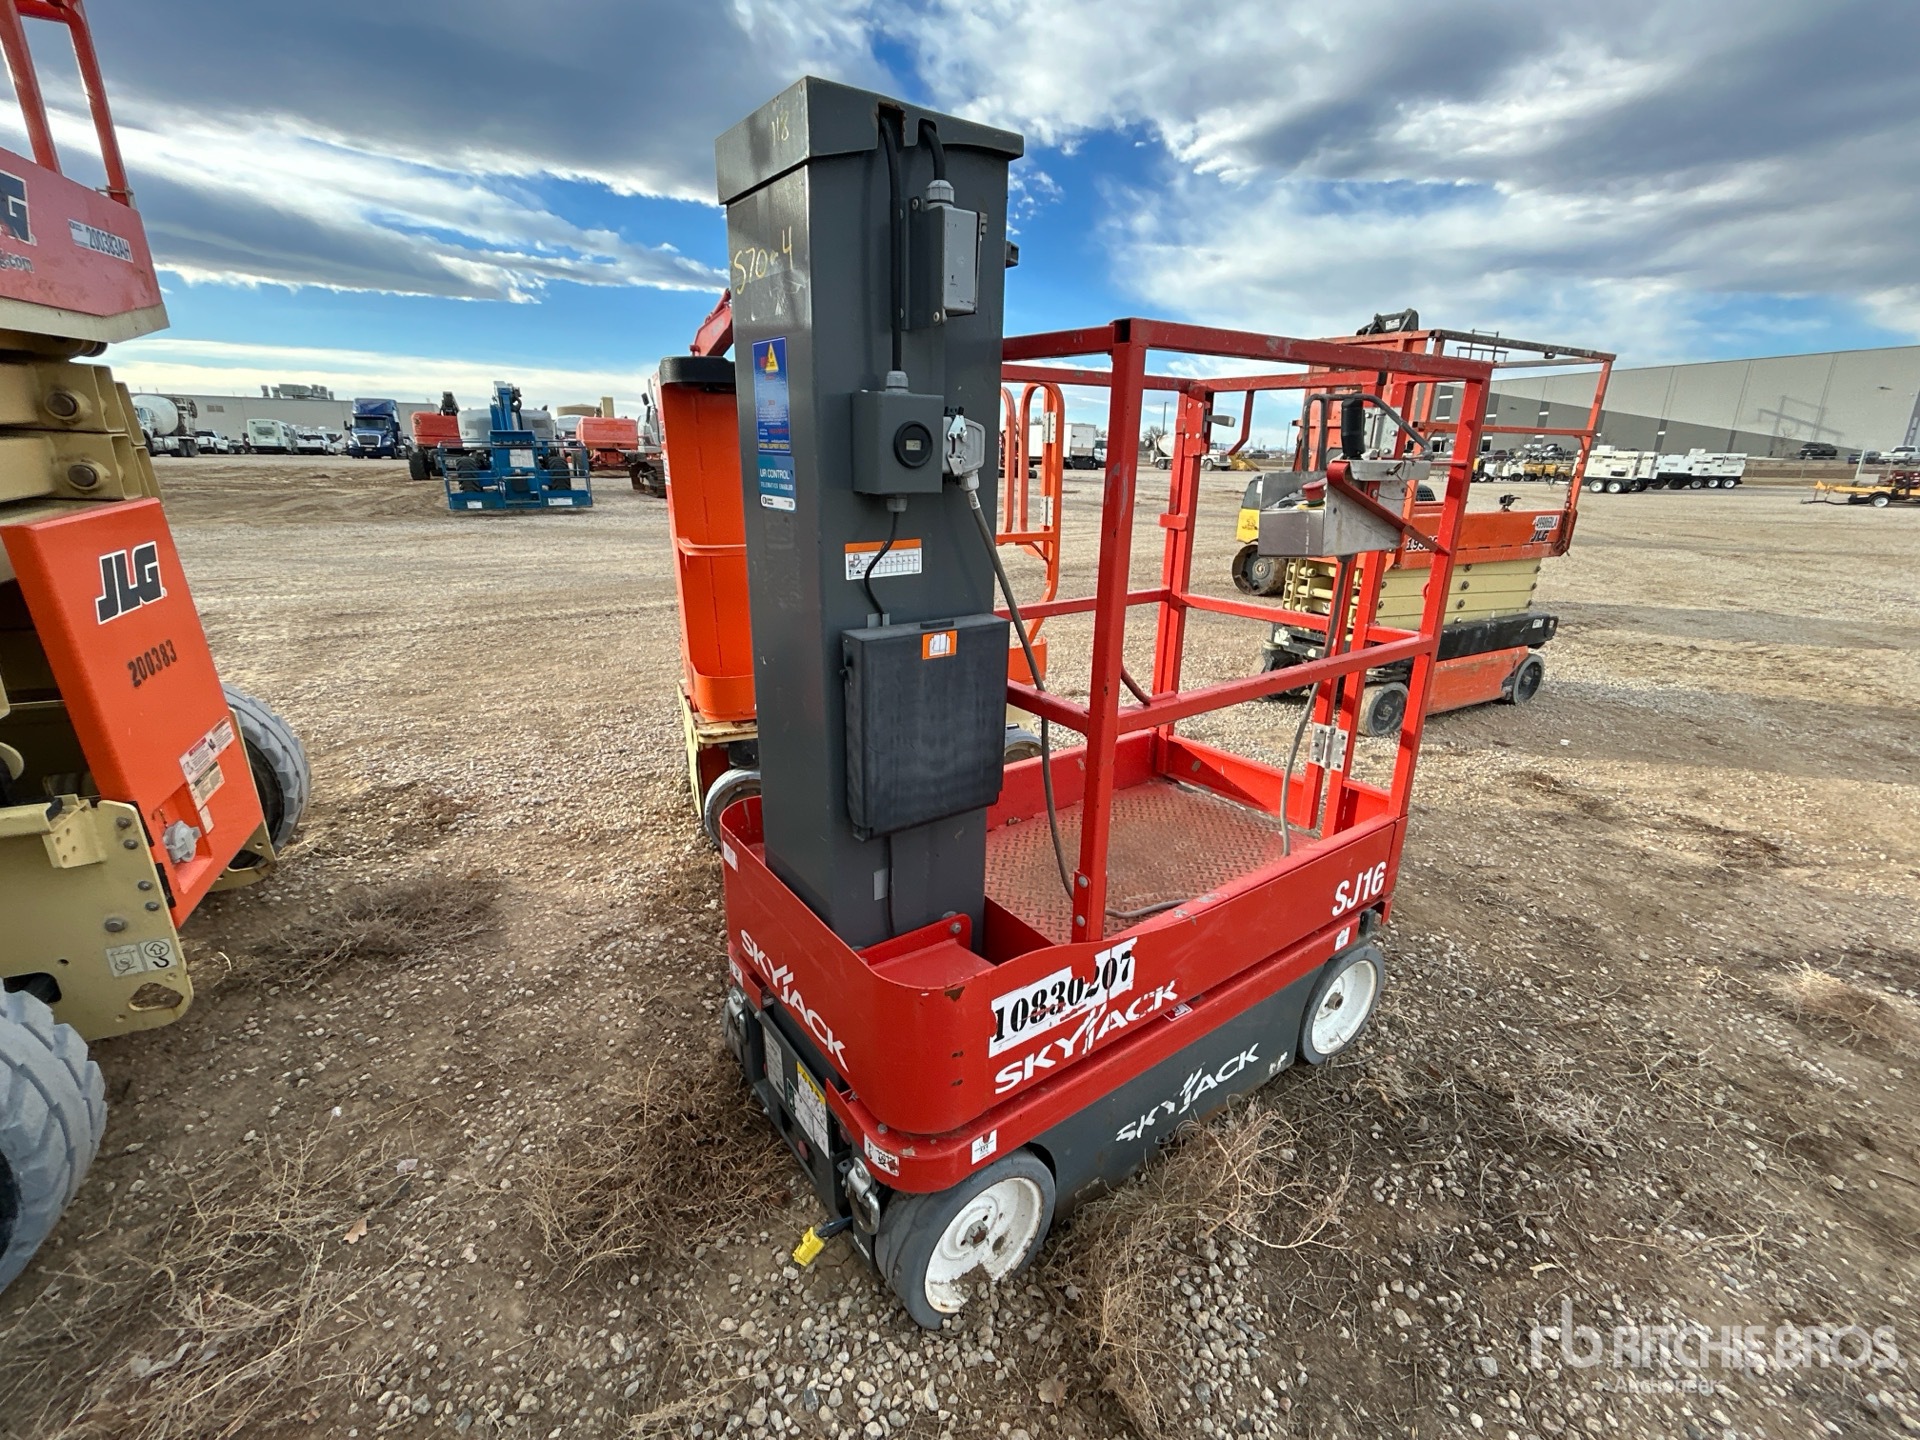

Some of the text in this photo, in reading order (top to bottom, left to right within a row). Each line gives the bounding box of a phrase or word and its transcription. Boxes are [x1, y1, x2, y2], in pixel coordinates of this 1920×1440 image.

[768, 469, 790, 480] CONTROL
[1530, 530, 1550, 543] JLG
[95, 541, 164, 625] JLG
[127, 639, 177, 688] 200383
[1332, 861, 1386, 917] SJ16
[741, 929, 849, 1073] SKYJACK
[995, 978, 1178, 1095] SKYJACK
